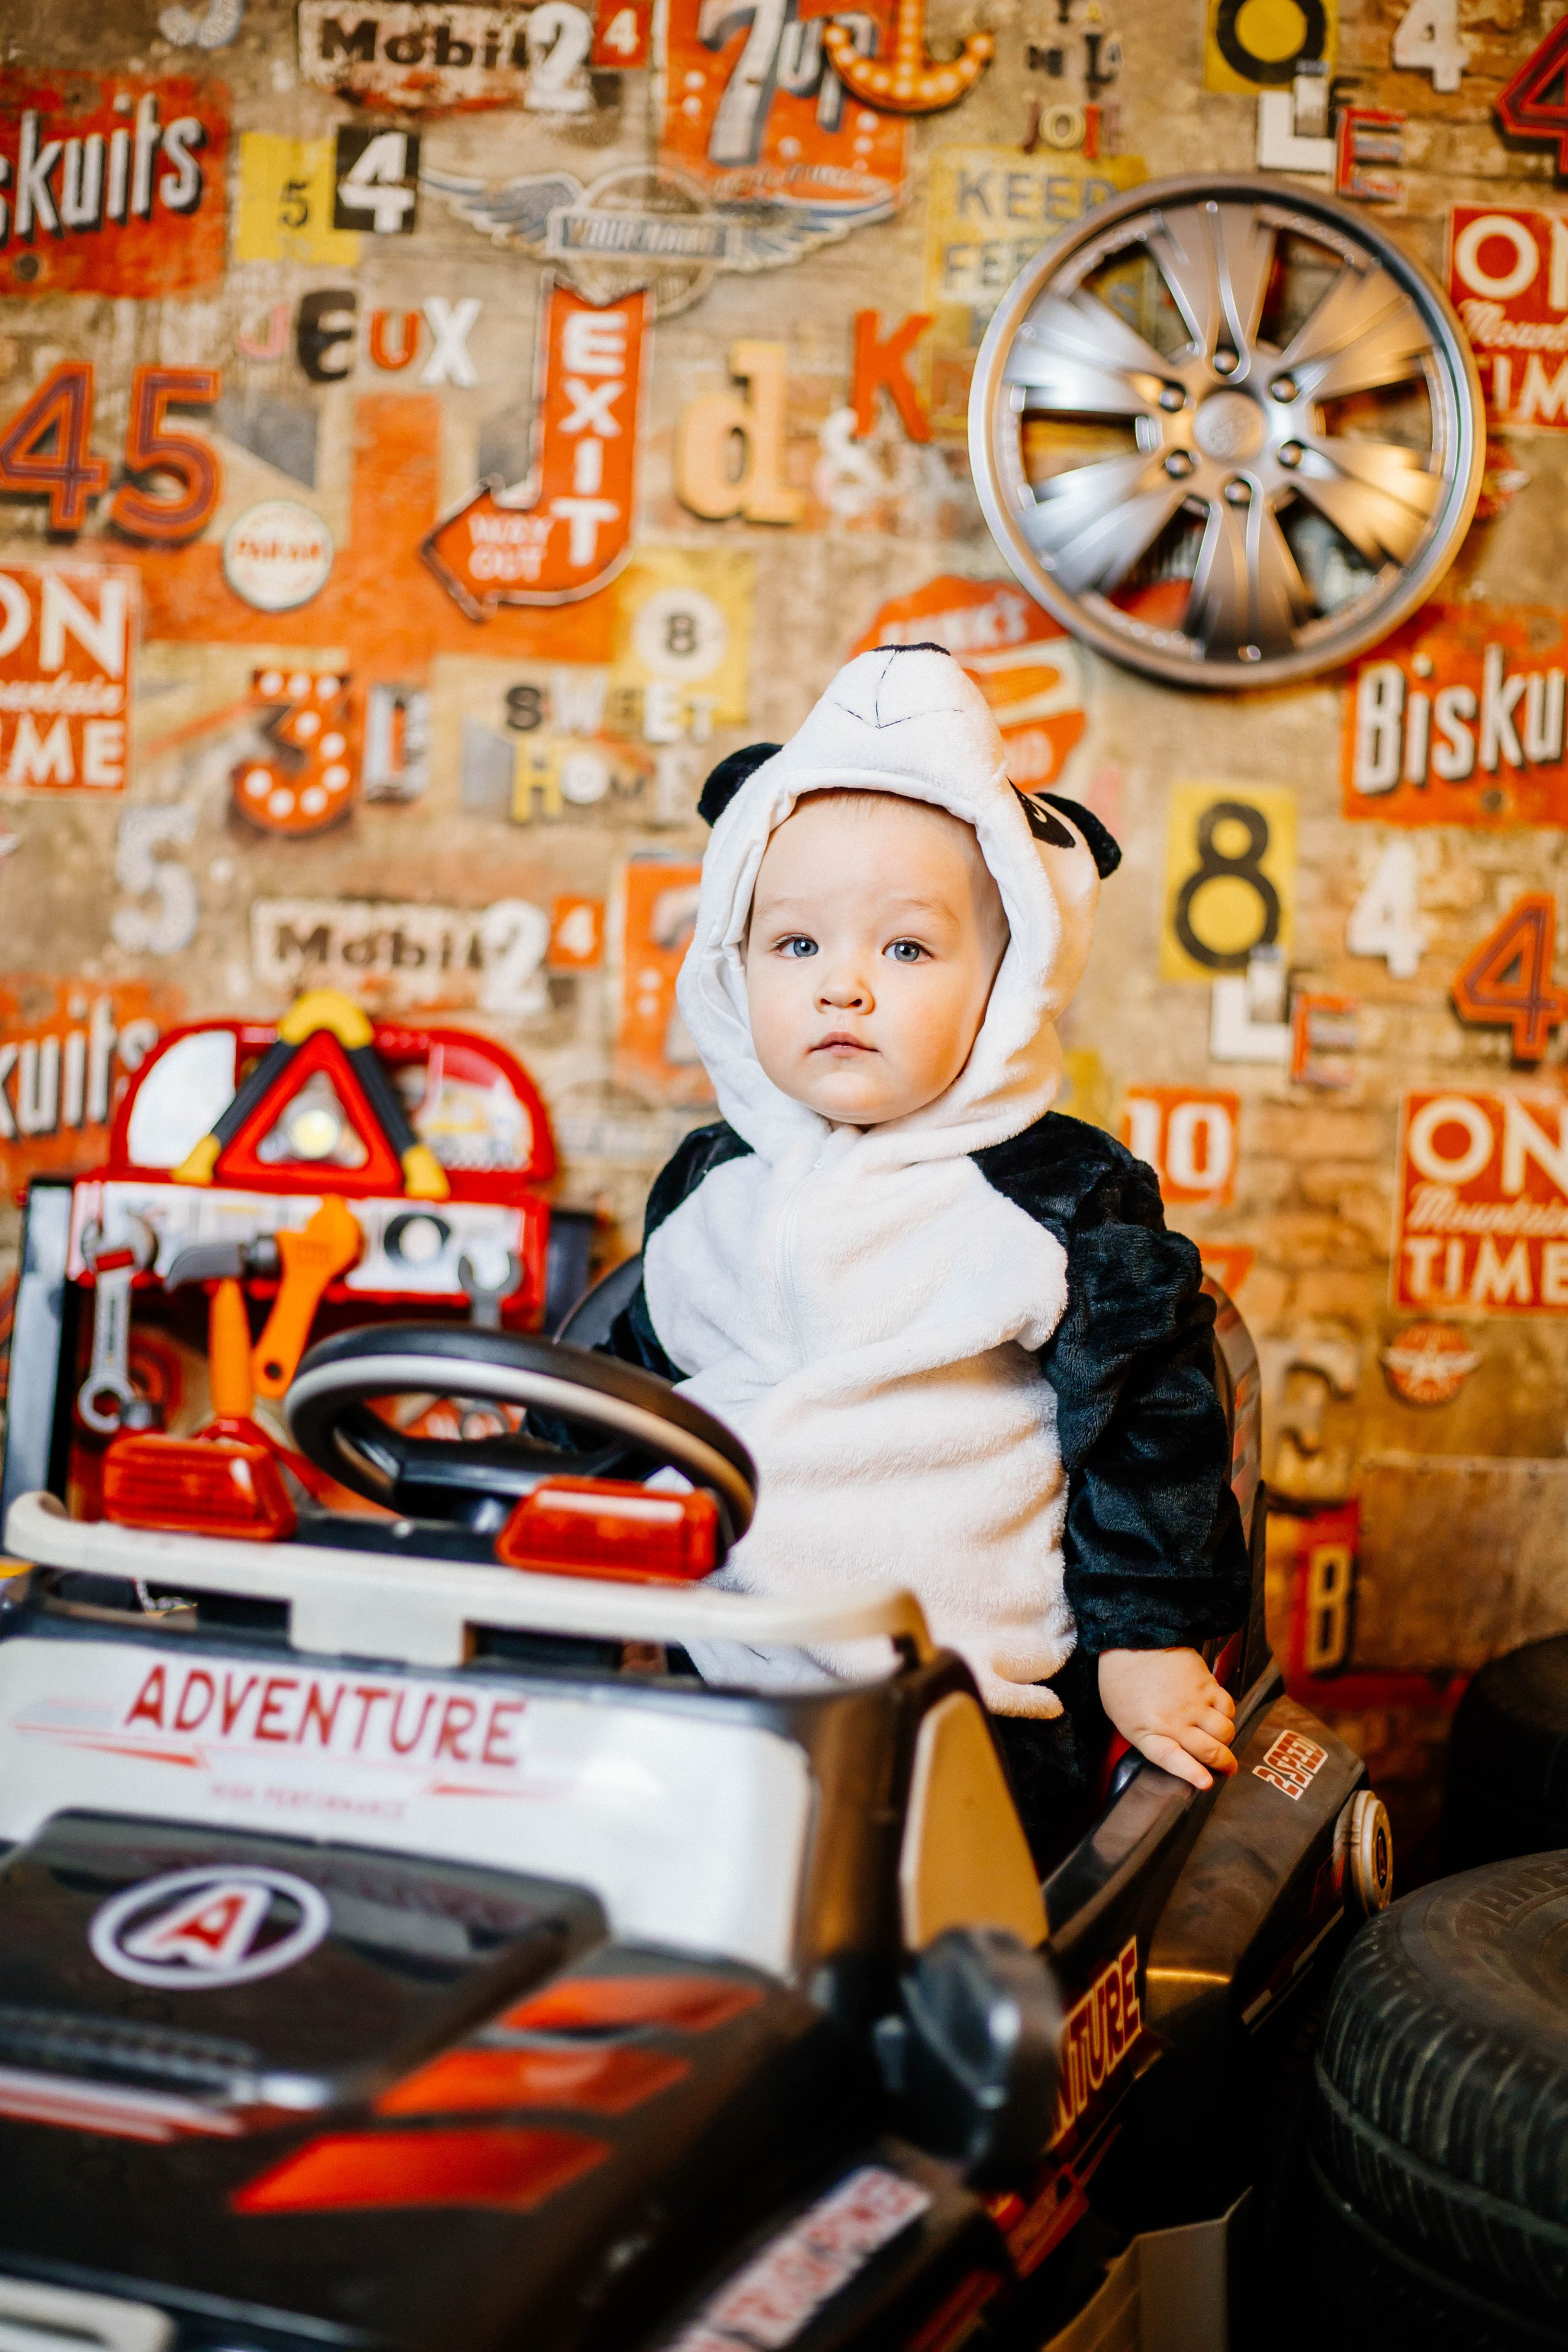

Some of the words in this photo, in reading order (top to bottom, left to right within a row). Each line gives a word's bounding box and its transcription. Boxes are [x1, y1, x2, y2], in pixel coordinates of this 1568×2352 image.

[339, 132, 415, 234] 4
[0, 361, 222, 541] 45
[556, 310, 627, 567] EXIT
[677, 339, 805, 524] d
[849, 309, 935, 443] K
[233, 668, 354, 836] 3
[111, 804, 200, 956] 5
[1175, 801, 1281, 971] 8
[1351, 840, 1428, 979] 4
[123, 1662, 528, 1768] ADVENTURE
